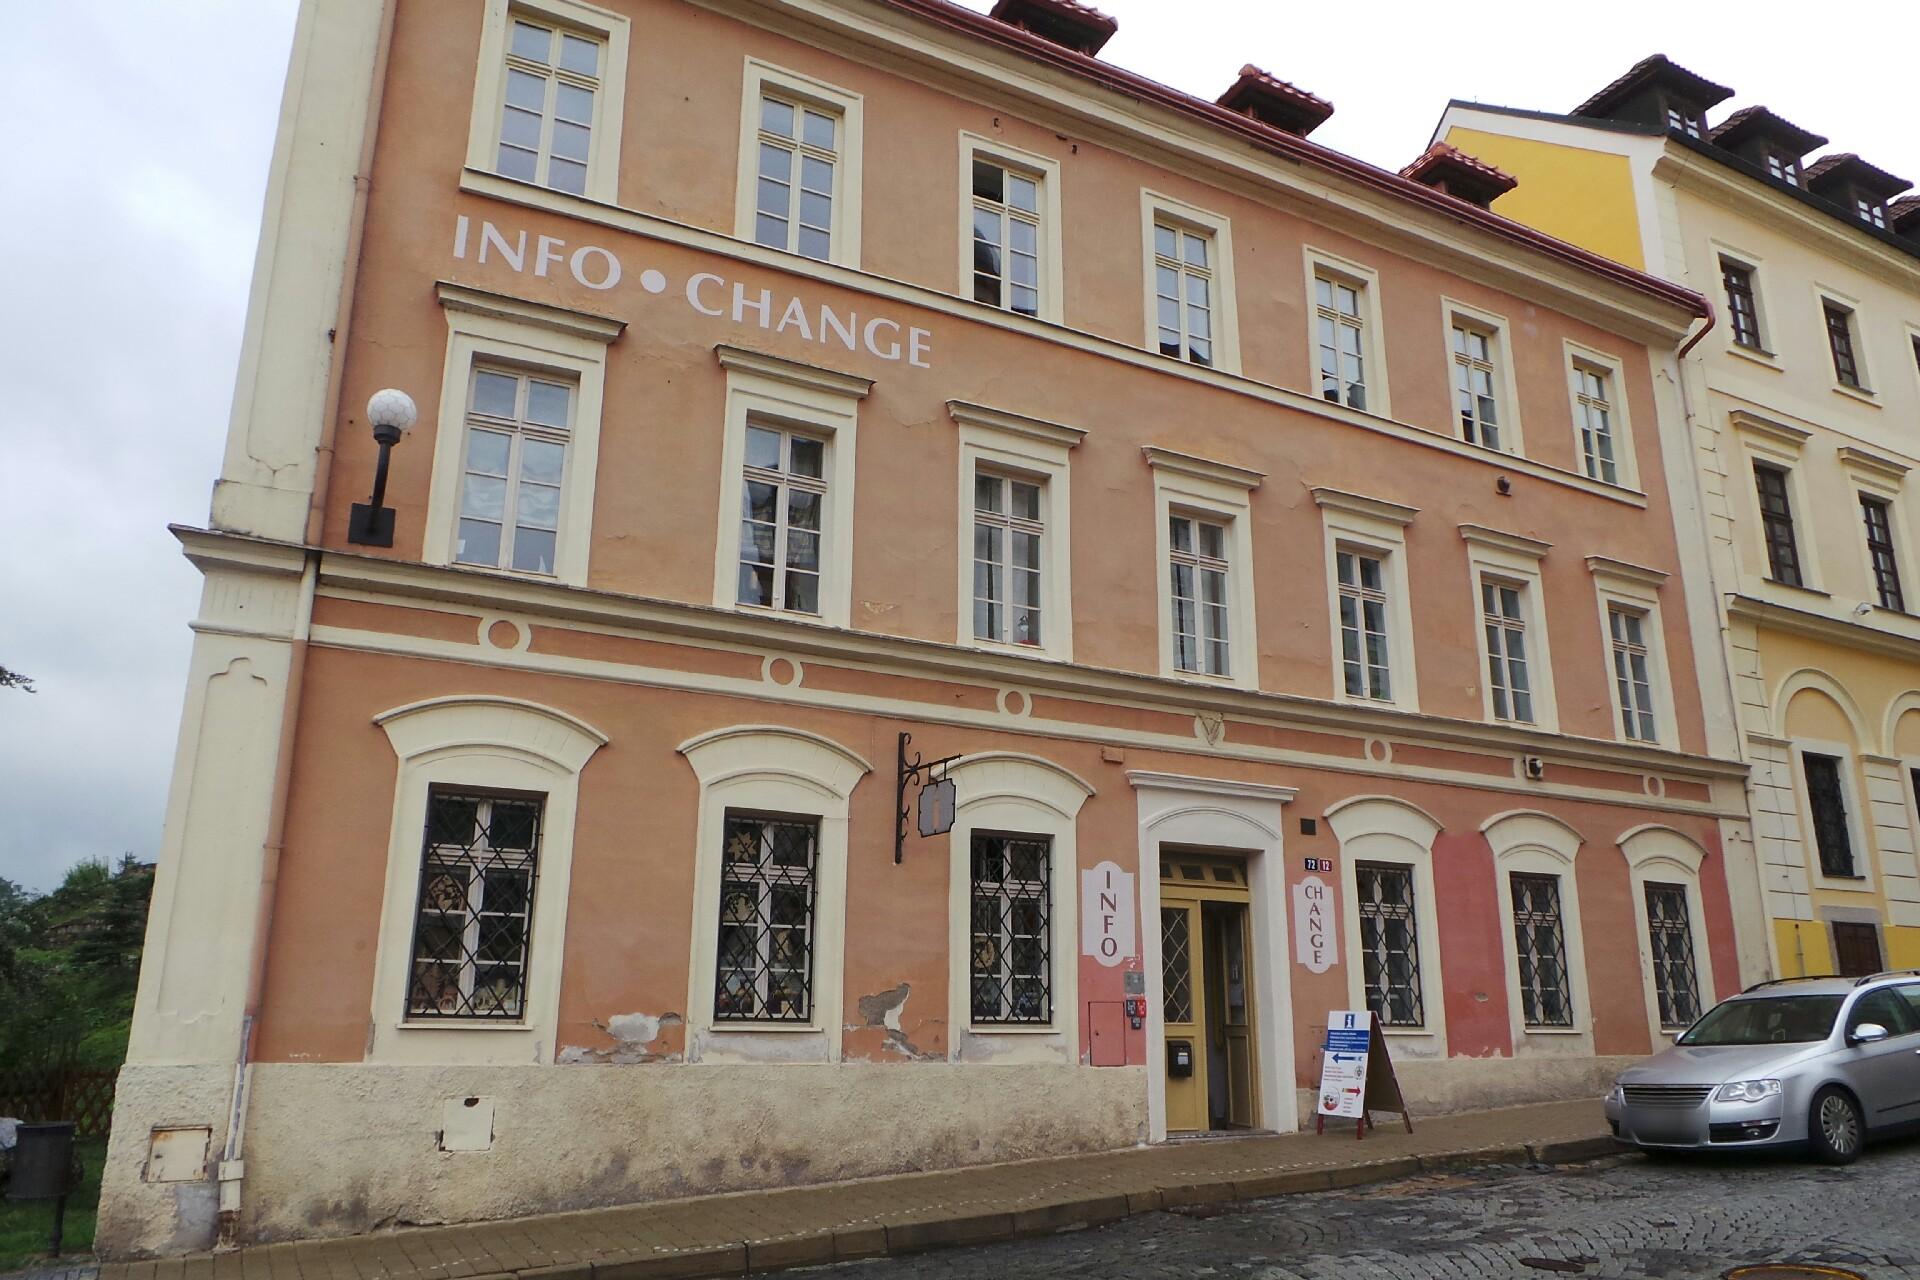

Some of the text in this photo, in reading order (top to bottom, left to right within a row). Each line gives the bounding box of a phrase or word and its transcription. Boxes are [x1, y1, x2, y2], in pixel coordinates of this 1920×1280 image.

[452, 214, 932, 369] INFO CHANGE
[1307, 859, 1316, 870] 72
[1322, 860, 1331, 871] 12
[1100, 870, 1118, 957] INFO
[1304, 884, 1324, 964] CHANGE
